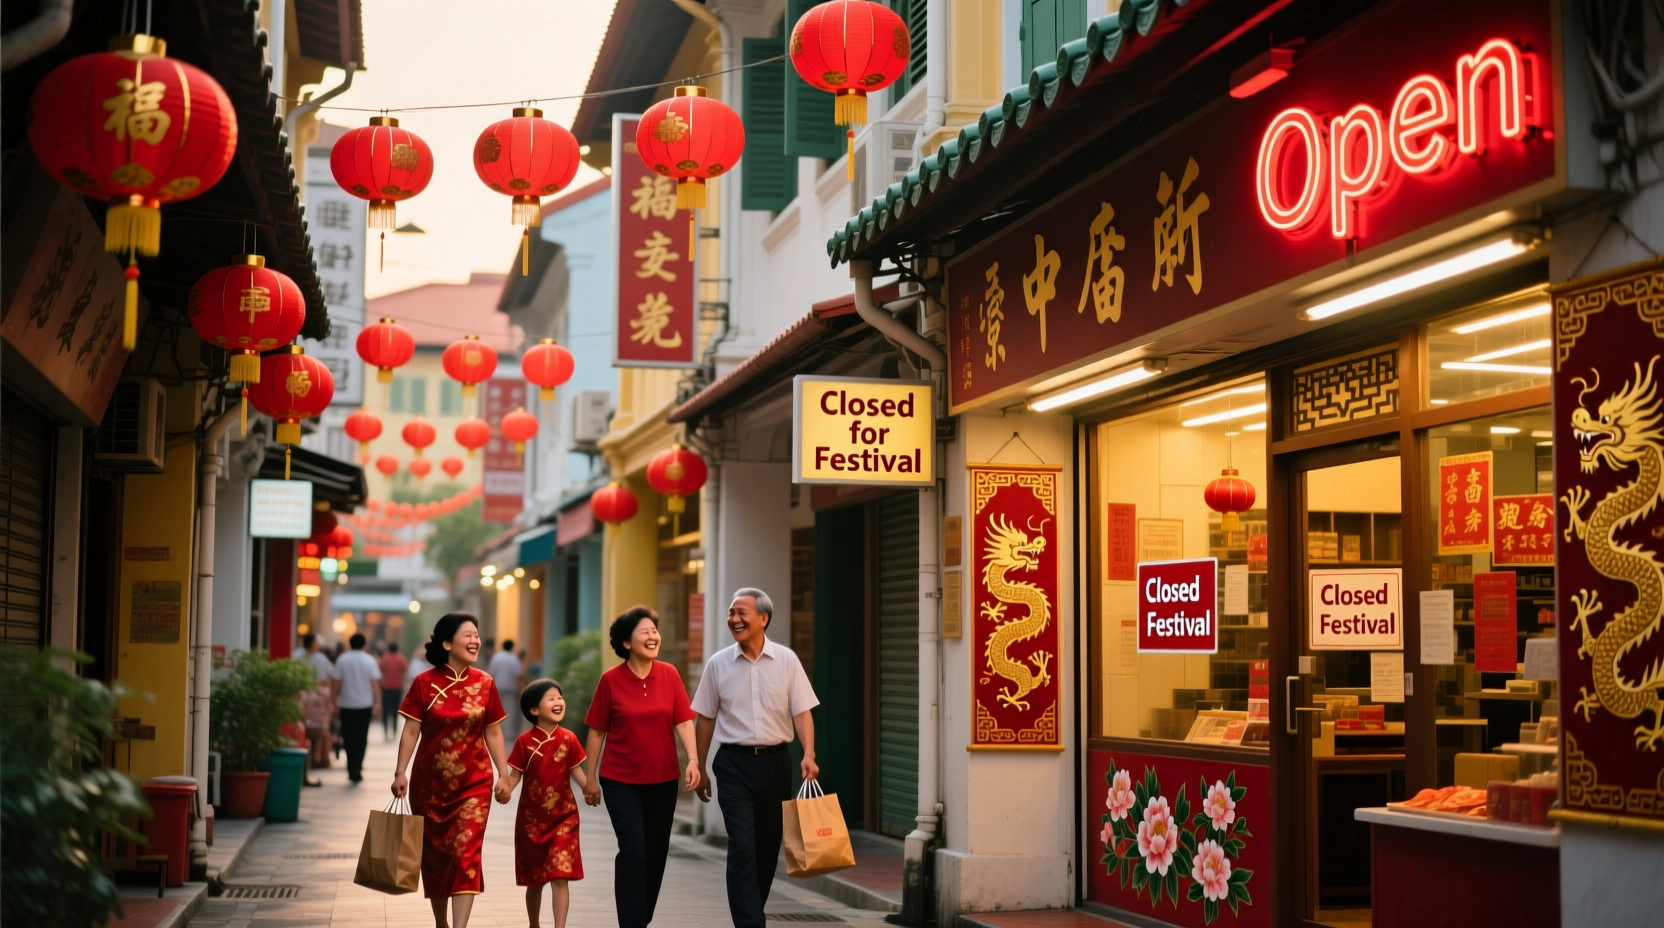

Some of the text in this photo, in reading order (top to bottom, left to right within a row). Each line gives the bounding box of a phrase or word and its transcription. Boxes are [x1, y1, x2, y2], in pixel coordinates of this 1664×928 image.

[103, 78, 171, 145] 福
[1256, 38, 1520, 238] Open
[820, 390, 915, 418] Closed
[849, 419, 890, 445] for
[815, 446, 921, 474] Festival
[1145, 574, 1200, 604] Closed
[1320, 583, 1388, 606] Closed
[1147, 609, 1211, 637] Festival
[1320, 612, 1395, 635] Festival
